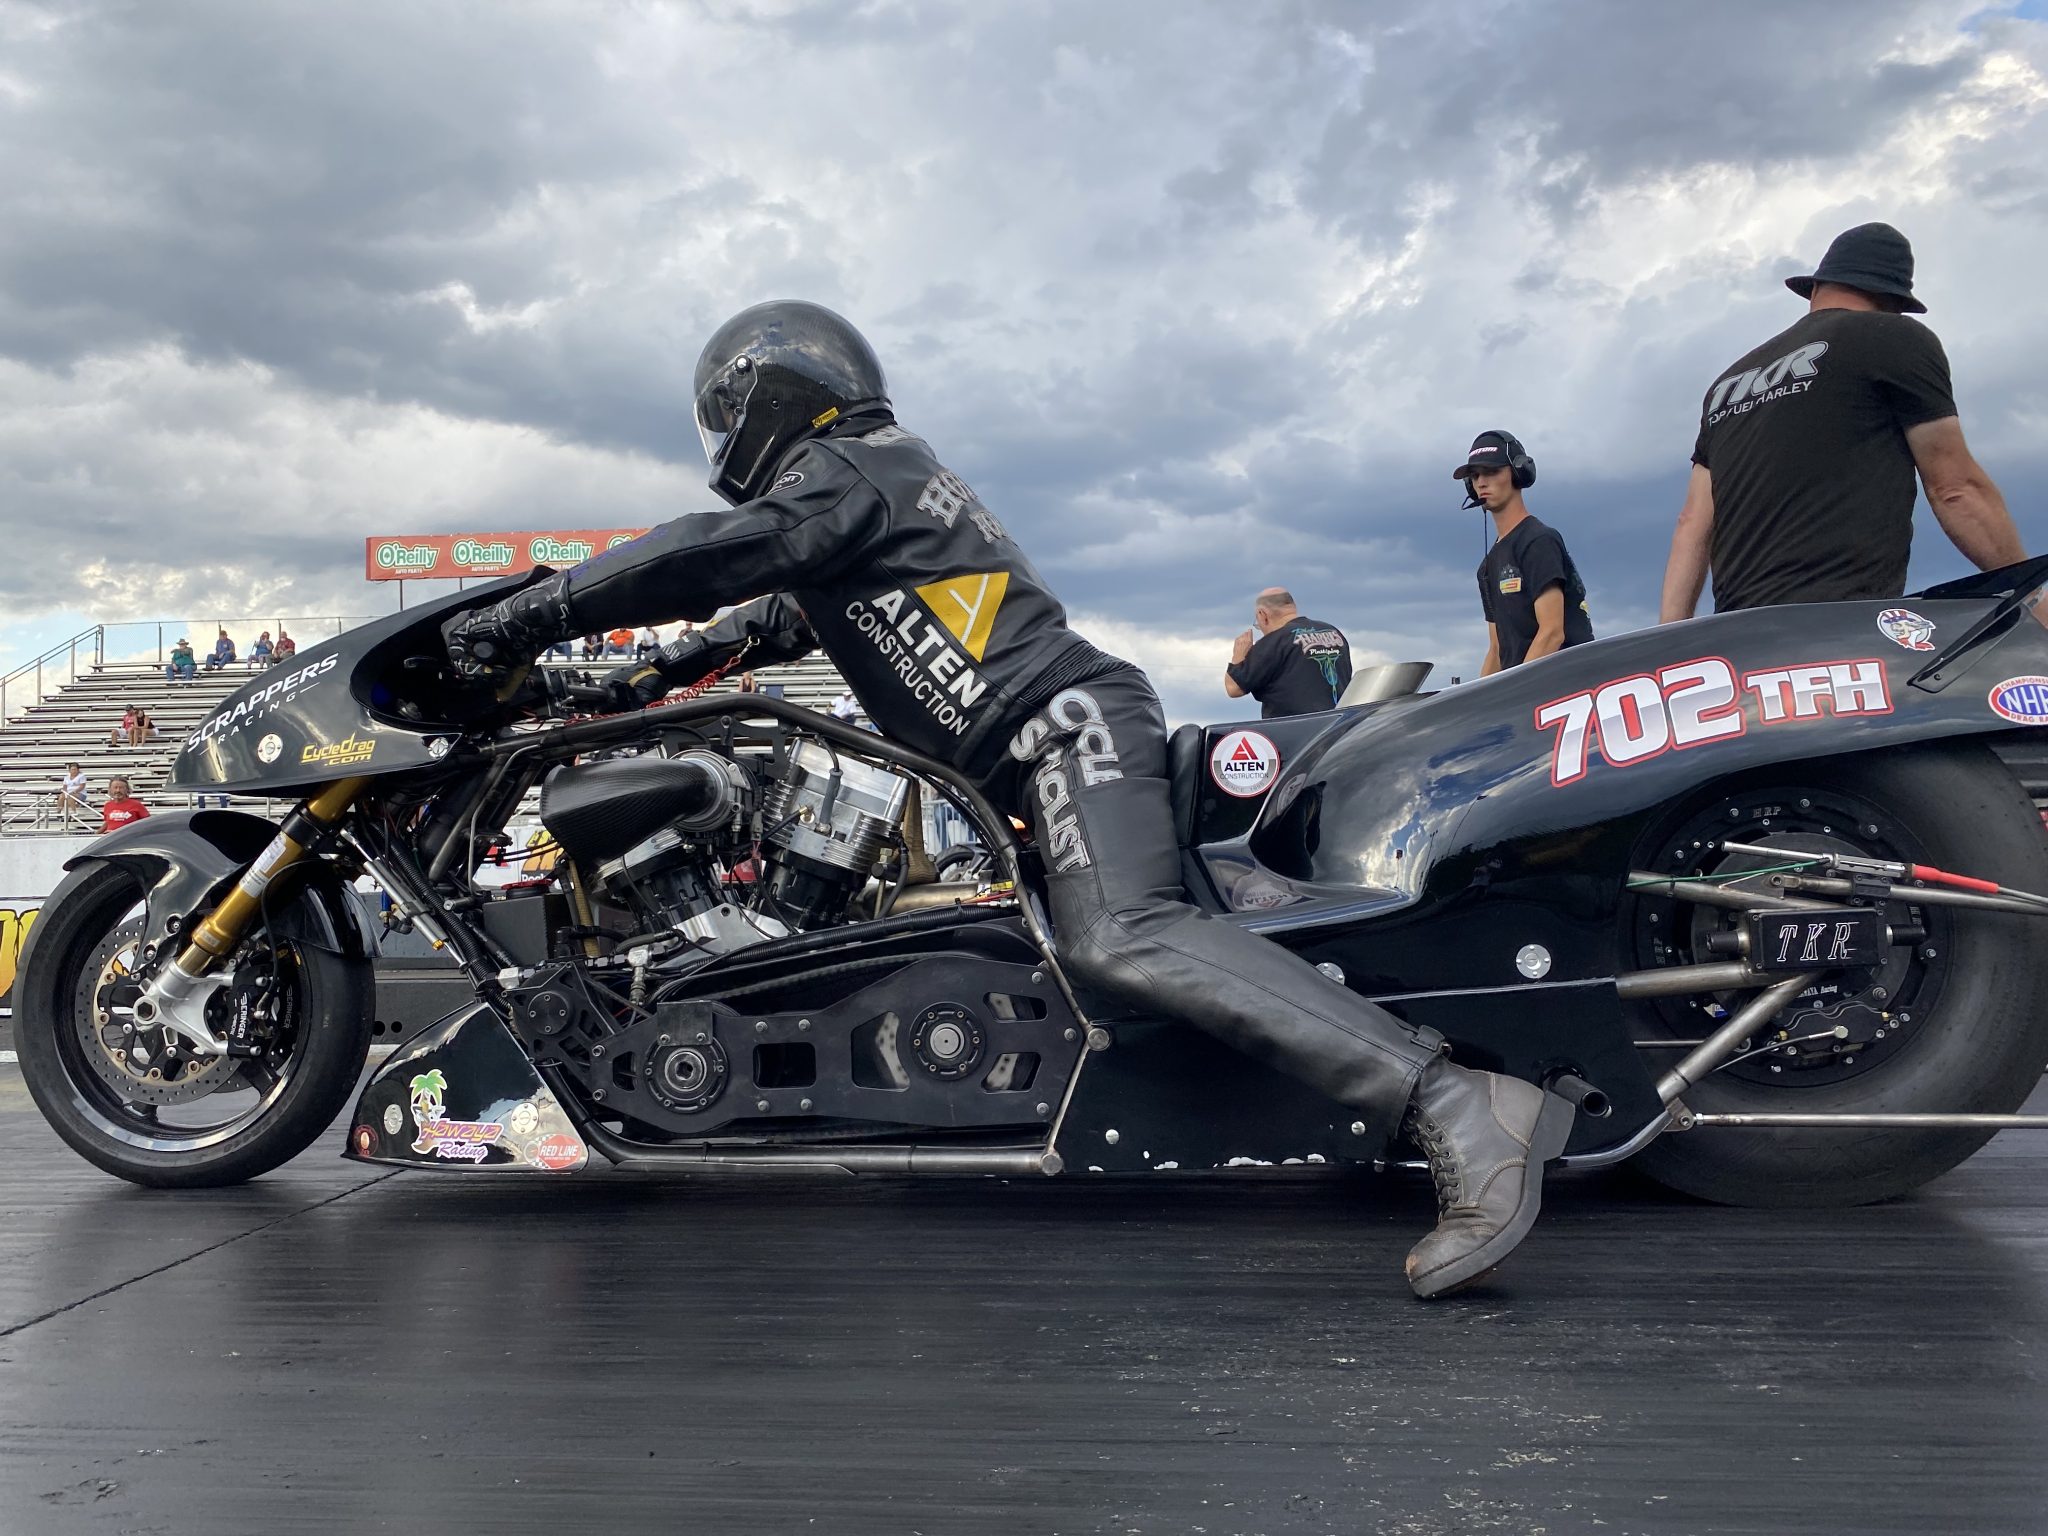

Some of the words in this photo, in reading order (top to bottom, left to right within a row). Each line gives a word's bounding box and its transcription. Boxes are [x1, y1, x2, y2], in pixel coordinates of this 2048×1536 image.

[377, 542, 438, 568] O'Reilly
[453, 540, 514, 567] O'Reilly
[531, 537, 592, 563] O'Reilly
[871, 589, 988, 709] ALTEN
[845, 600, 973, 736] CONSTRUCTION
[188, 652, 339, 753] SCRAPPERS
[2003, 685, 2048, 714] NHR
[217, 691, 297, 745] RACING
[1537, 658, 1744, 785] 702
[1745, 660, 1892, 723] TFH
[302, 732, 376, 762] CycleDrag
[324, 753, 372, 767] .com
[1220, 772, 1269, 780] CONSTRUCTION
[1224, 761, 1265, 772] ALTEN
[1776, 922, 1852, 962] TKR
[438, 1140, 487, 1163] Racing
[540, 1145, 558, 1156] RED
[558, 1145, 579, 1156] LINE
